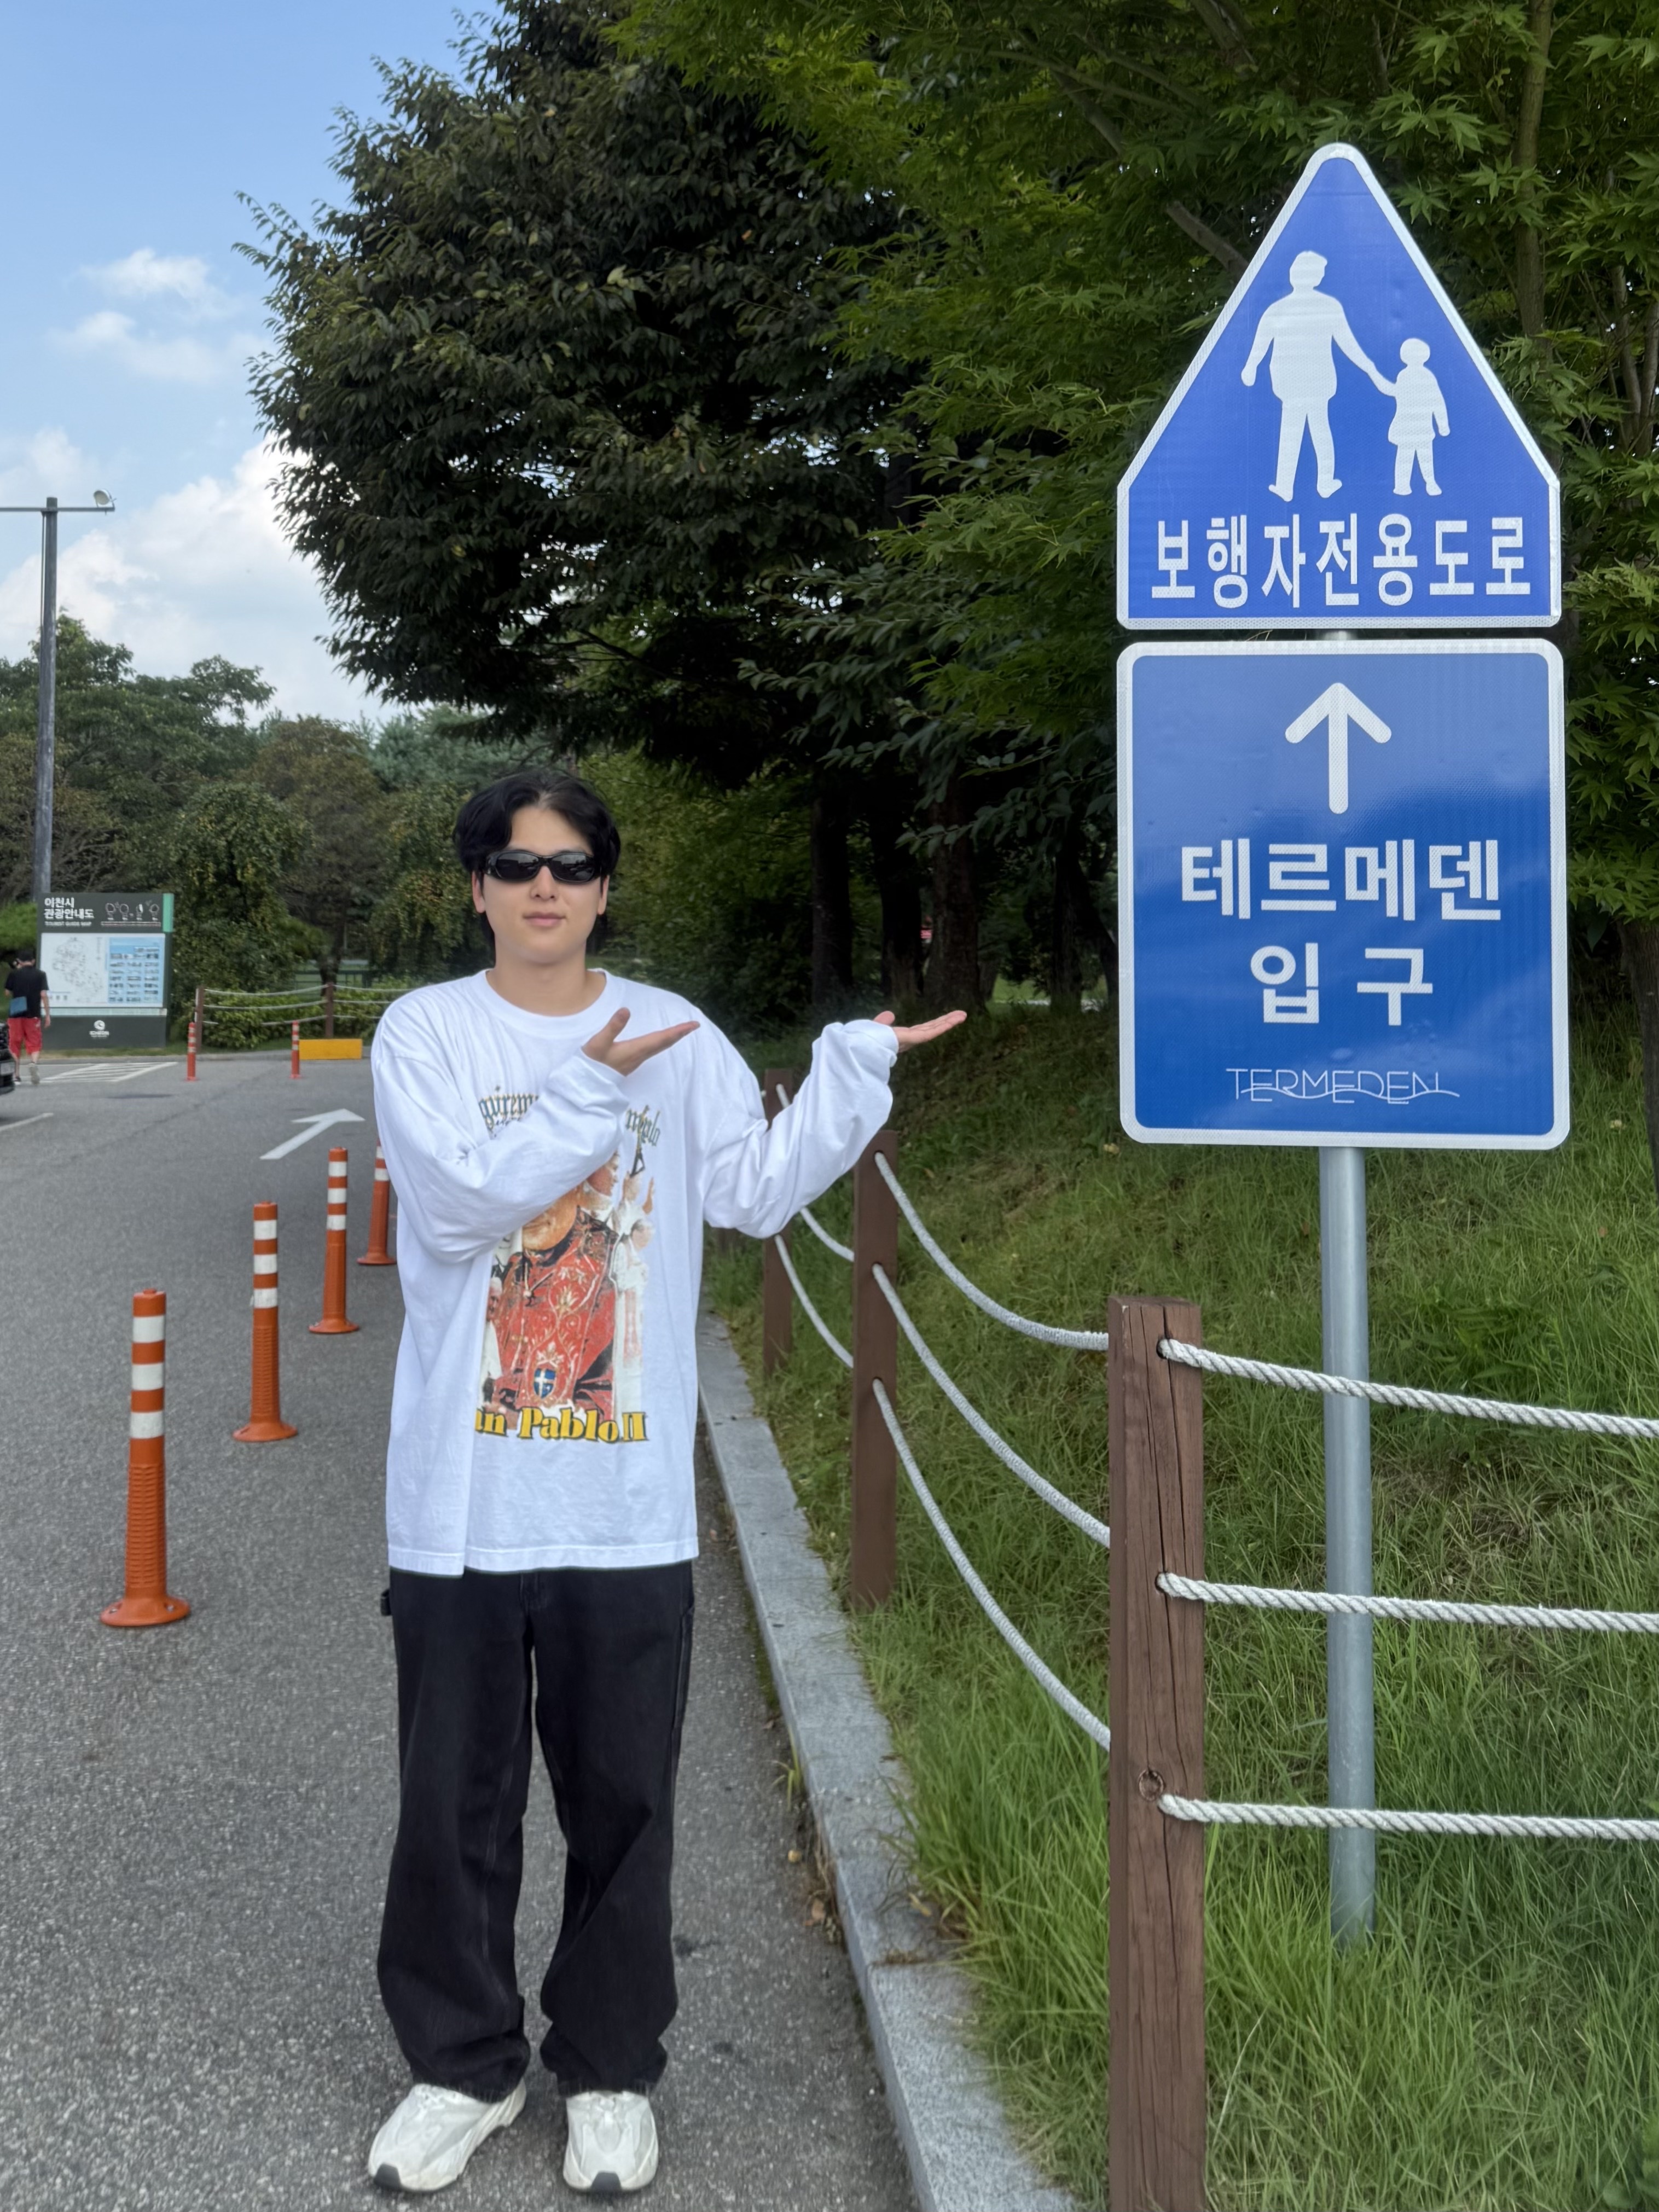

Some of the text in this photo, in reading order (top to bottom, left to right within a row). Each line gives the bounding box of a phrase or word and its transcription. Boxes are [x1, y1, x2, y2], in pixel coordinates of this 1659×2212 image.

[1151, 513, 1532, 609] 보행자전용도로
[1181, 838, 1502, 921] 테르메덴
[44, 897, 74, 908] 이천시
[44, 908, 95, 919] 관광안내도
[1226, 1069, 1440, 1105] TERMEDEN
[517, 1406, 619, 1443] Pablo
